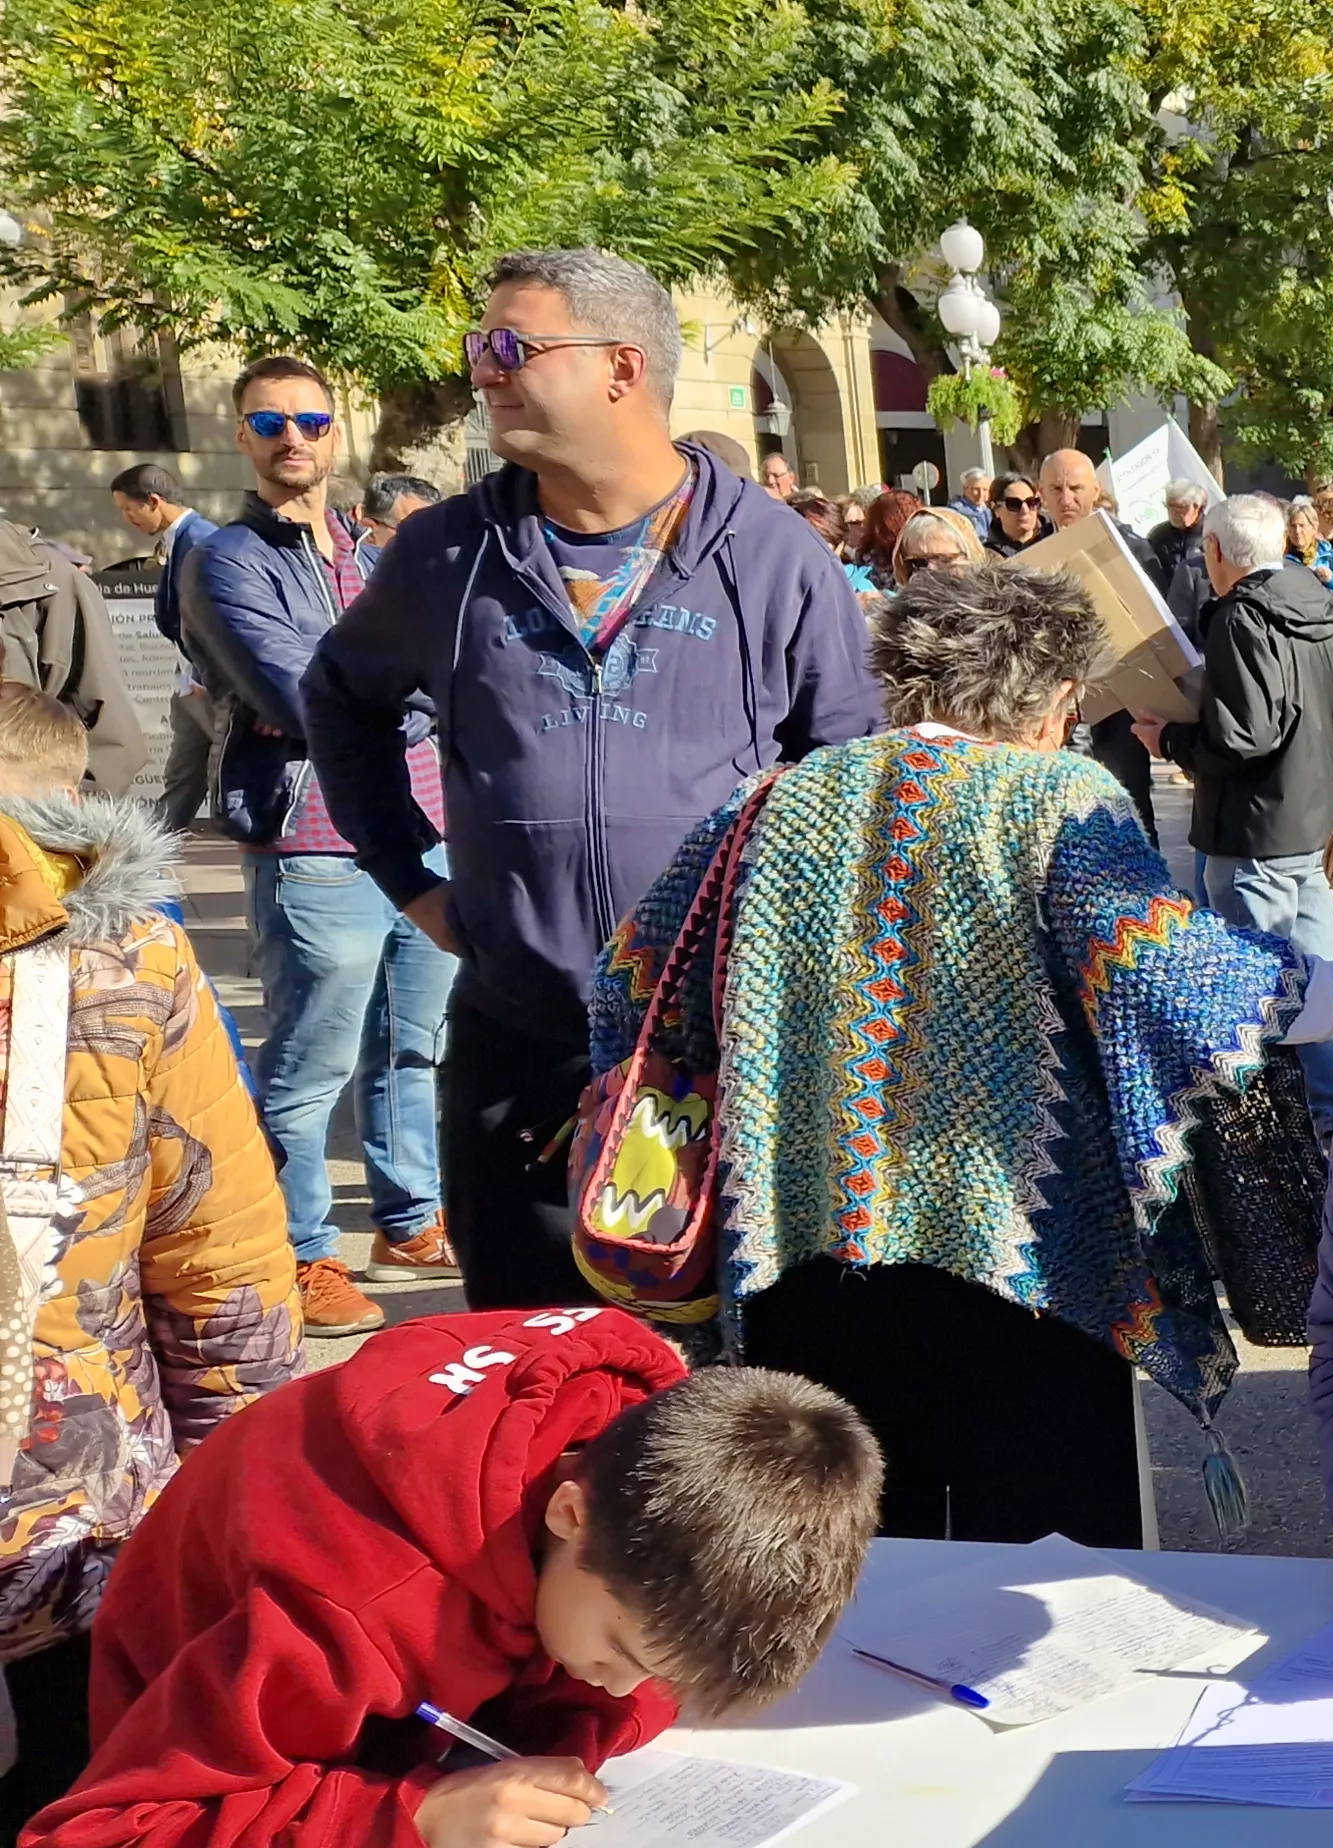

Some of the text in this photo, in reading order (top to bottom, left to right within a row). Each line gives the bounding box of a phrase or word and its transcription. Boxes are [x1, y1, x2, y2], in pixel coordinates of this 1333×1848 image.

[133, 582, 160, 594] Hue
[111, 612, 135, 625] IÓN
[135, 629, 162, 639] Salu
[541, 703, 648, 730] LIVING
